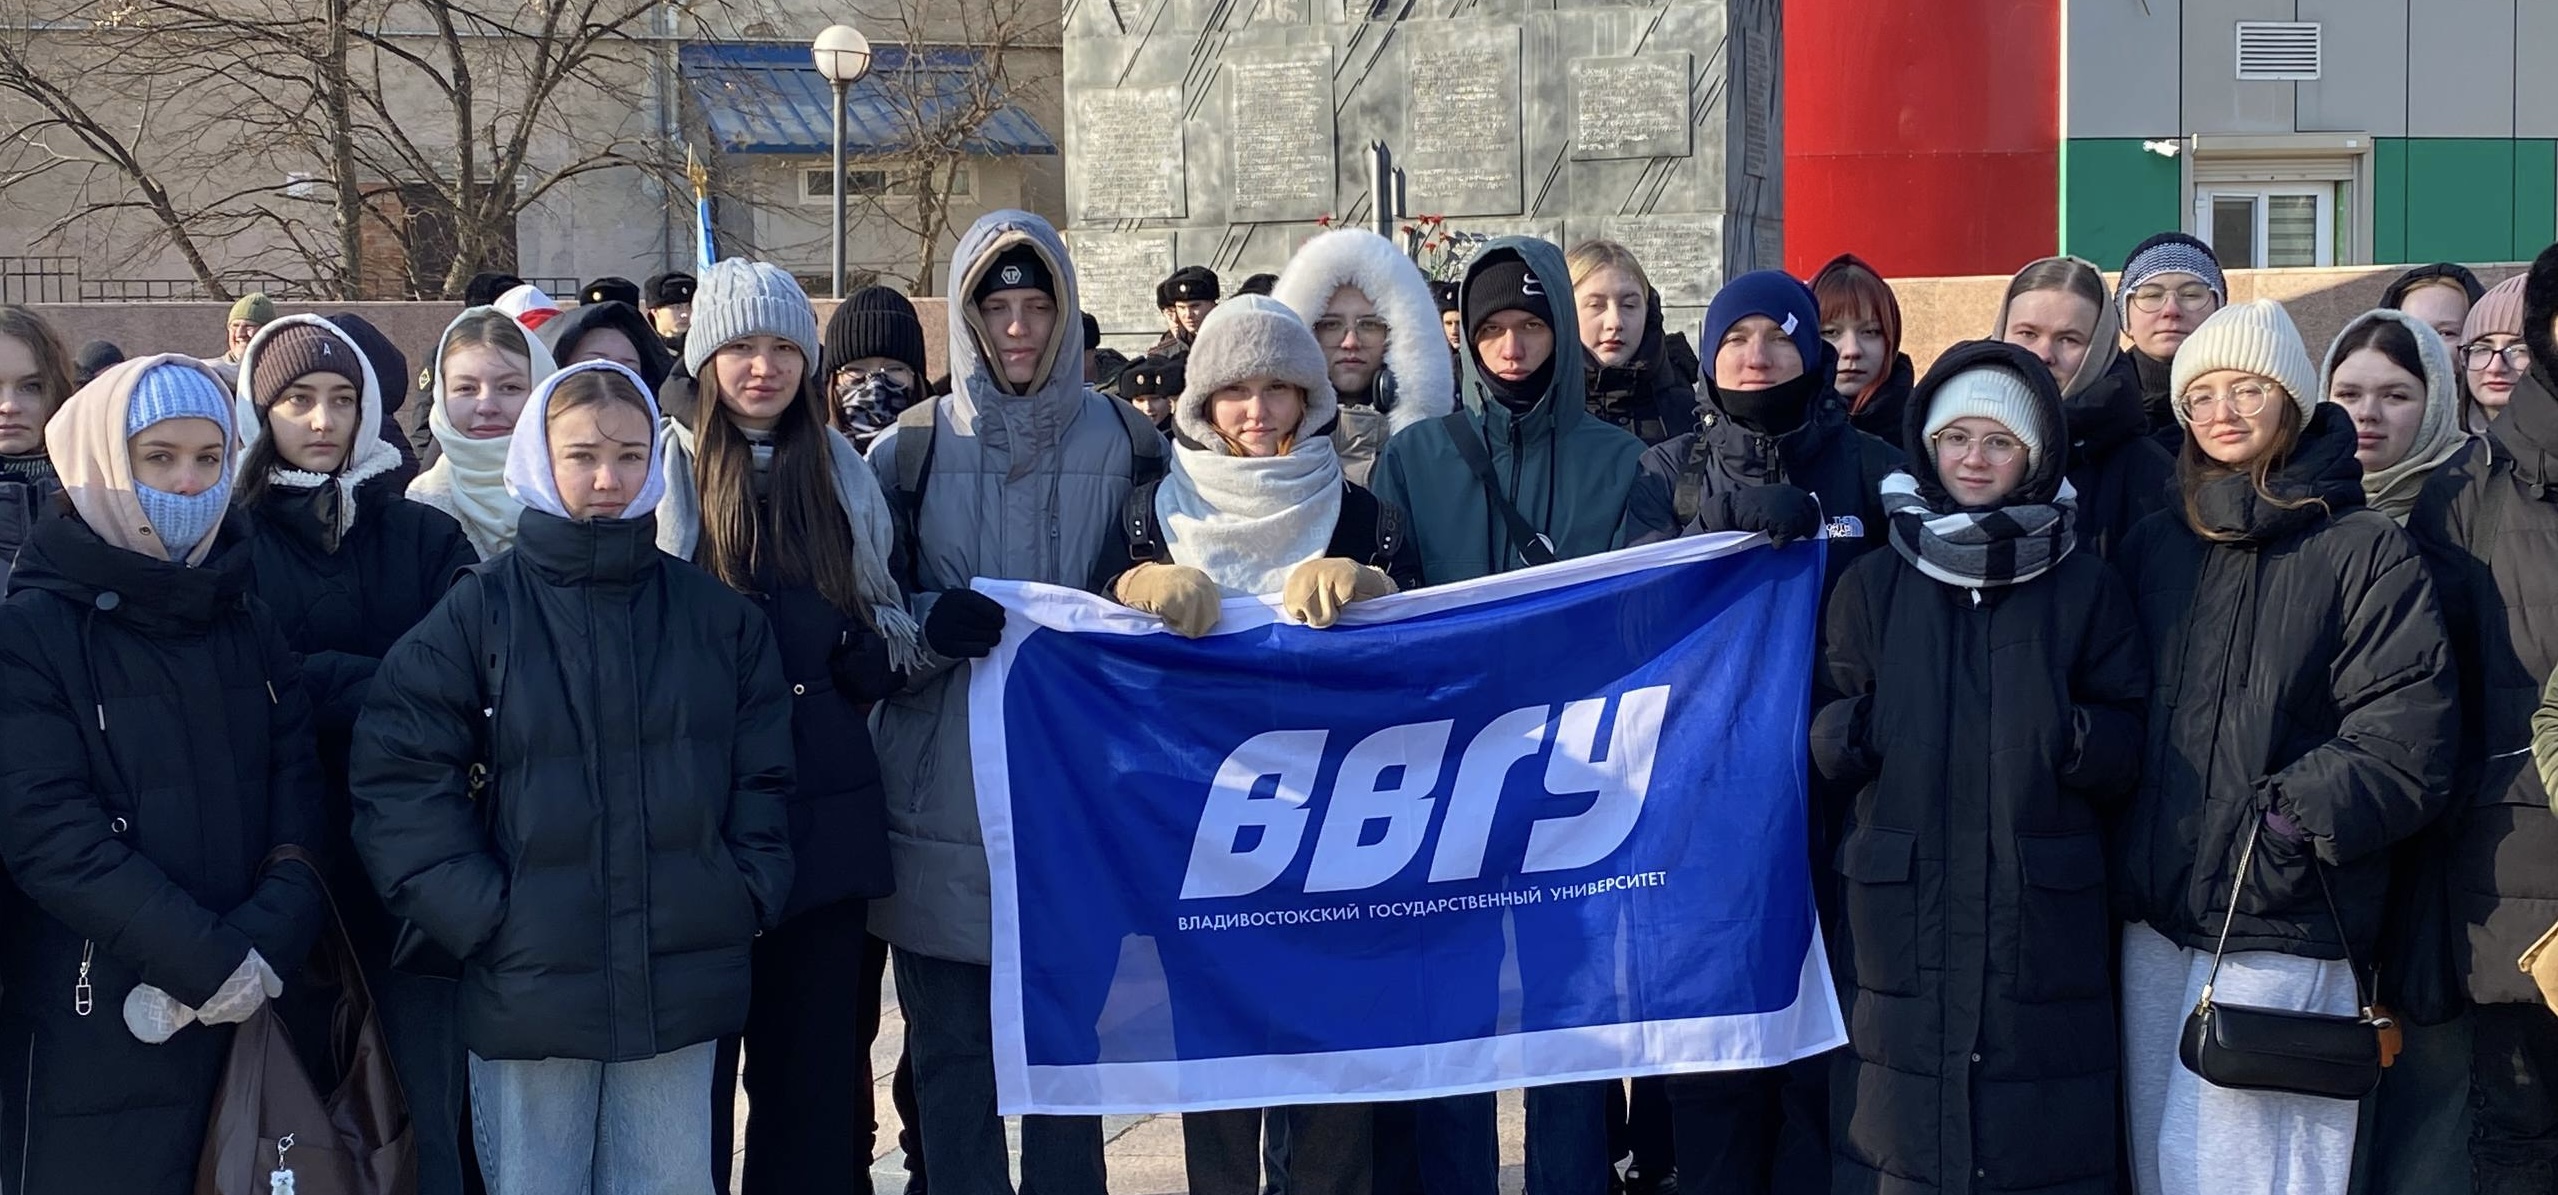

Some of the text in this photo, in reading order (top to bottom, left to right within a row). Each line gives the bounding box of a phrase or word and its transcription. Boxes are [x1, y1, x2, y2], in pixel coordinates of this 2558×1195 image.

[323, 342, 332, 355] A
[1826, 523, 1850, 531] ORTH
[1828, 530, 1851, 538] FACE
[1179, 684, 1671, 899] ВВГУ
[1178, 871, 1667, 931] ВЛАДИВОСТОКСКИЙ ГОСУДАРСТВЕННЫЙ УНИВЕРСИТЕТ
